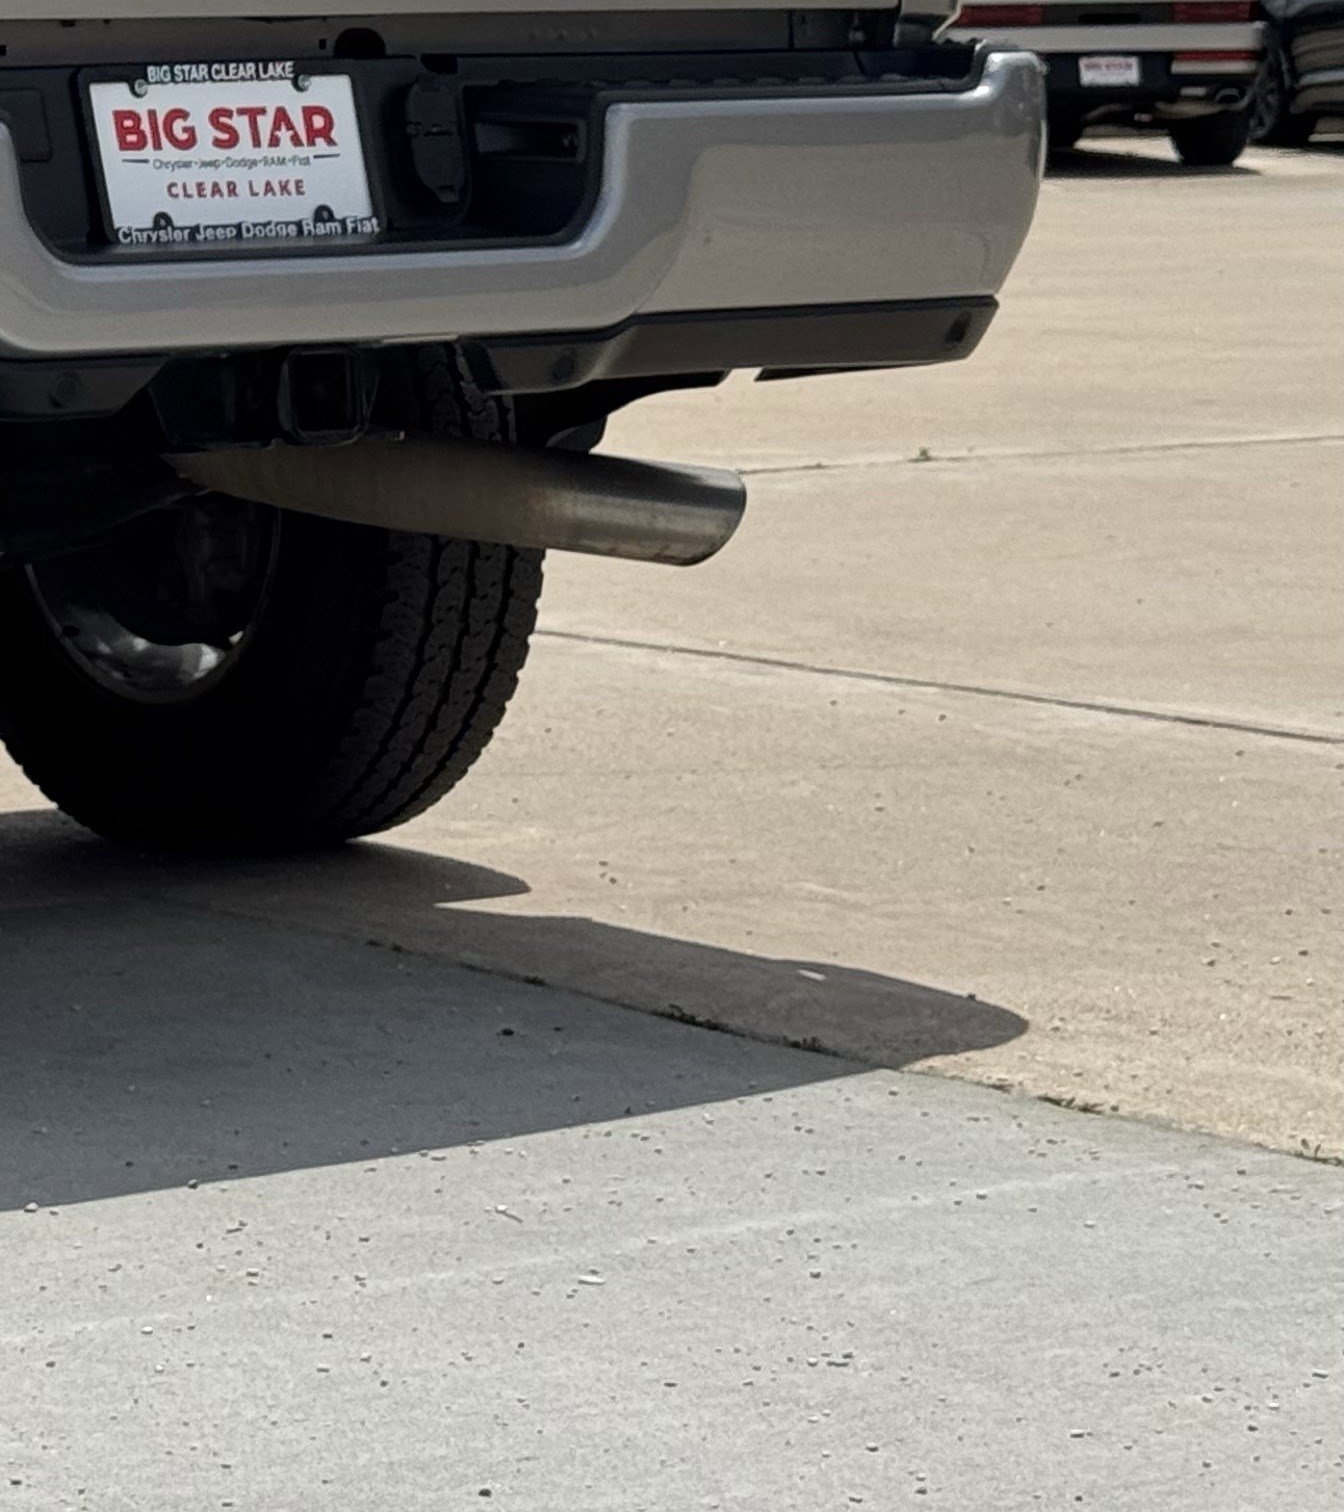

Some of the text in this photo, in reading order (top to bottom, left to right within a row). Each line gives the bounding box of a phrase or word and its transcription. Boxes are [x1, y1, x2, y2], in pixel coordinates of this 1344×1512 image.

[147, 60, 296, 83] BIG STAR CLEAR LAKE
[113, 105, 339, 151] BIG STAR
[166, 179, 306, 199] CLEAR LAKE
[117, 225, 192, 245] Chrysler
[301, 217, 342, 237] Ram
[345, 215, 380, 235] Fiat
